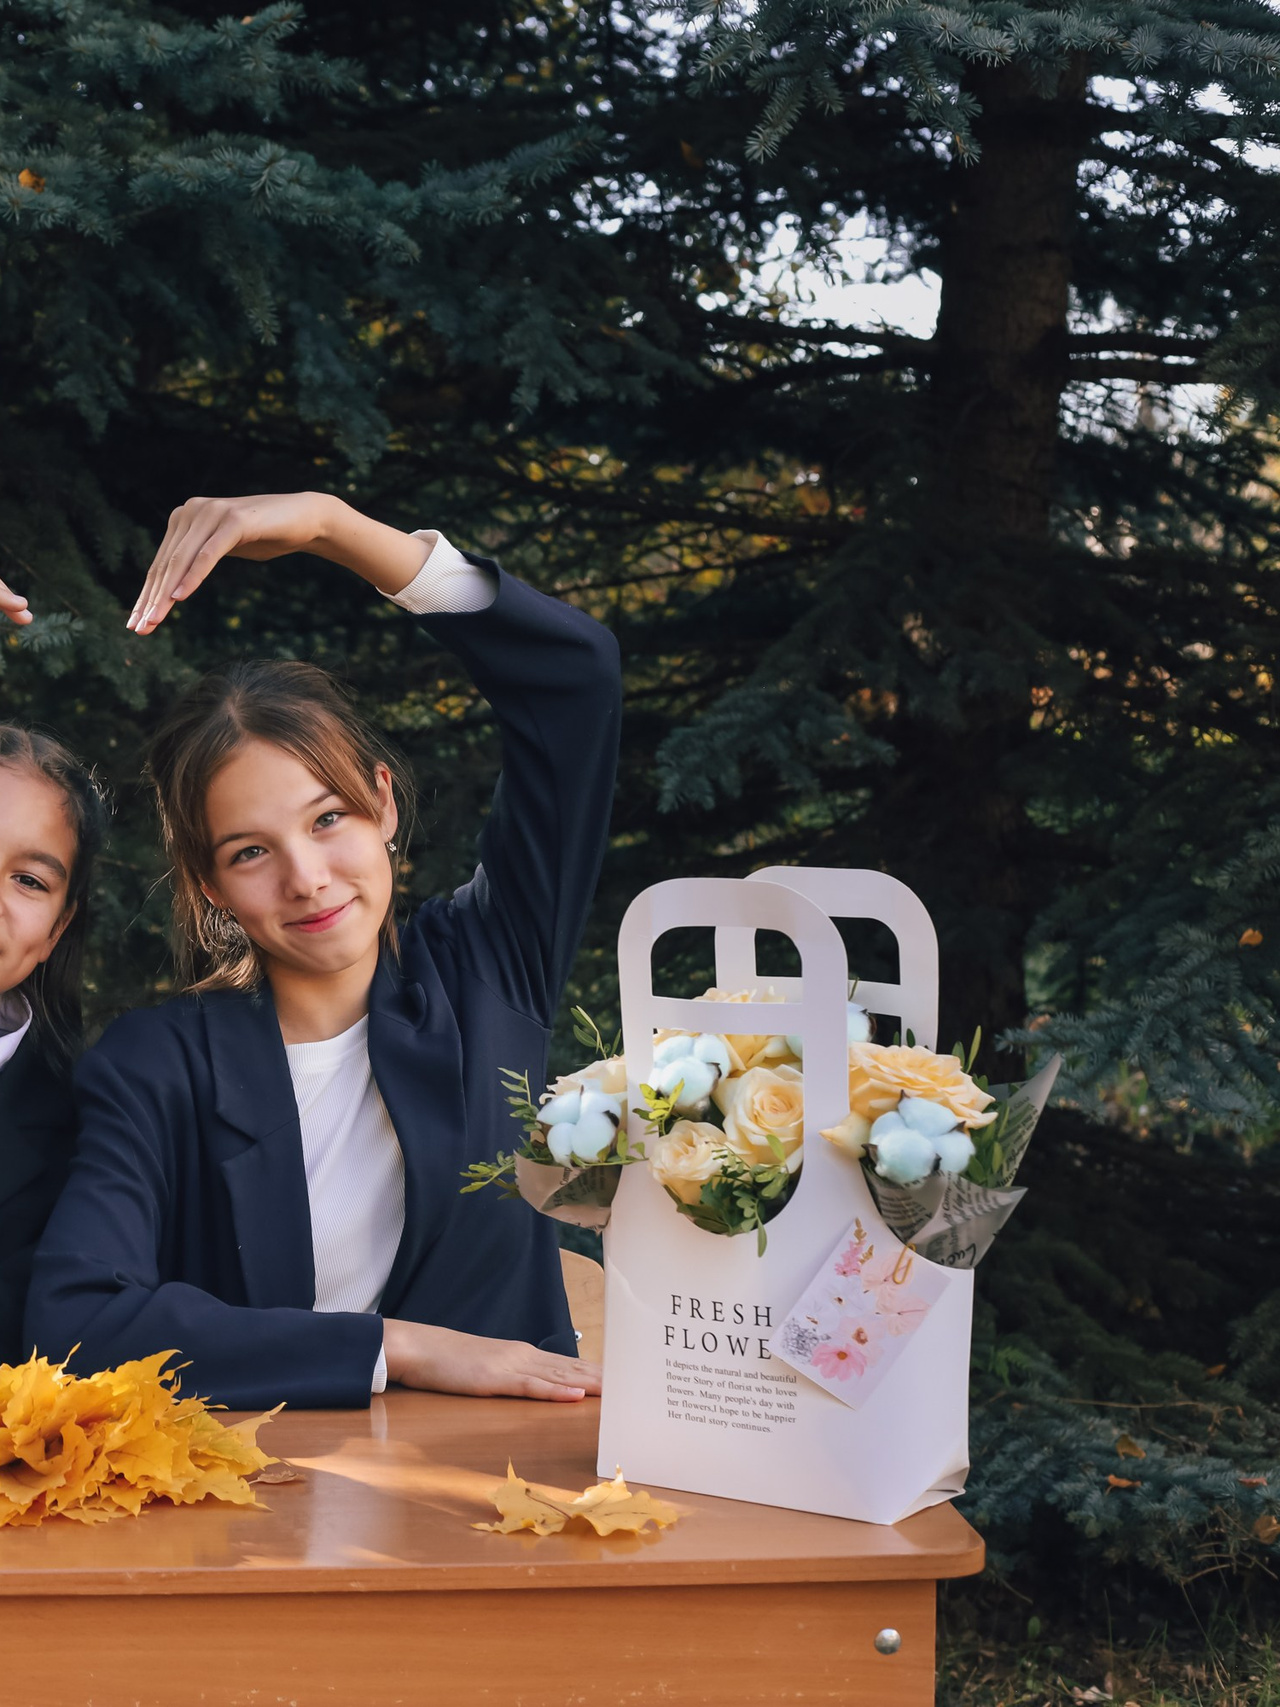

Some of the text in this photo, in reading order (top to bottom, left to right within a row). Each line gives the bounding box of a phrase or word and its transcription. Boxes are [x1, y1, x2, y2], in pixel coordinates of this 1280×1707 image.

[671, 1294, 773, 1327] FRESH
[664, 1325, 776, 1360] FLOWE
[666, 1372, 798, 1397] flower Story of florist who loves
[673, 1360, 699, 1372] depicts
[701, 1364, 713, 1373] the
[714, 1367, 742, 1378] natural
[744, 1371, 758, 1380] and
[760, 1372, 797, 1384] beautiful
[667, 1397, 680, 1407] her
[719, 1405, 739, 1417] hope
[741, 1408, 750, 1418] to
[752, 1409, 762, 1419] be
[764, 1411, 797, 1424] happier
[699, 1390, 721, 1402] Many
[758, 1399, 774, 1410] day
[776, 1401, 795, 1411] with
[668, 1410, 682, 1420] Her
[684, 1412, 706, 1424] floral
[708, 1417, 729, 1428] story
